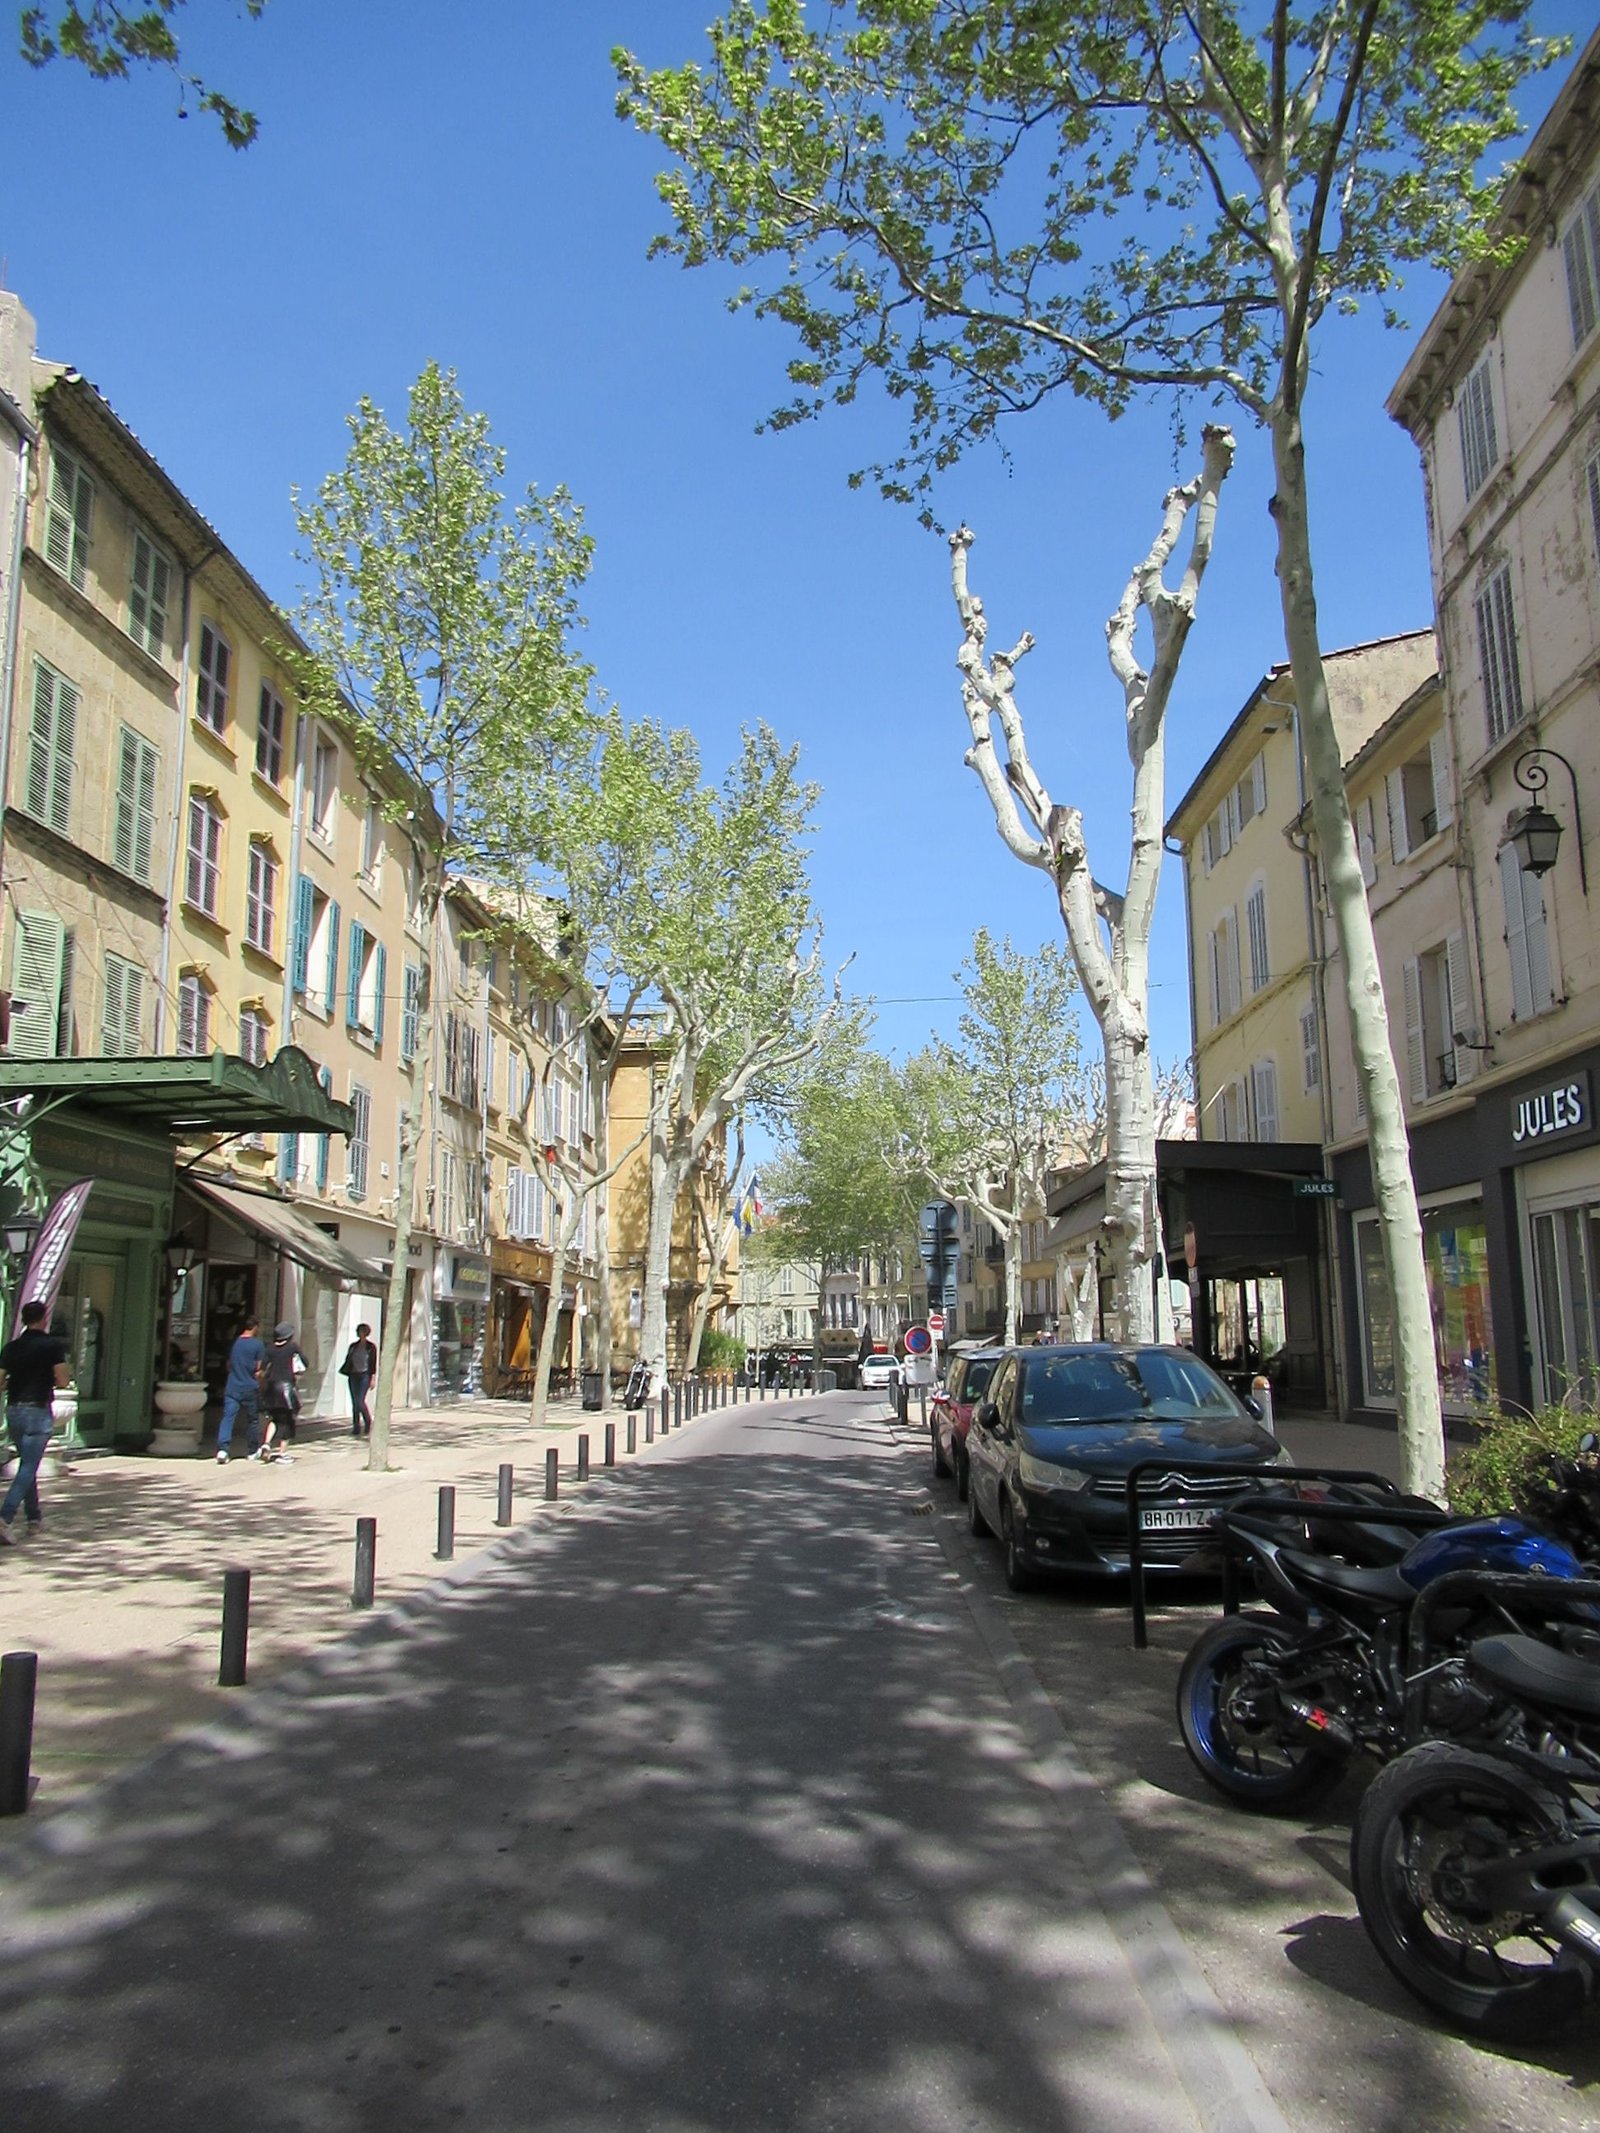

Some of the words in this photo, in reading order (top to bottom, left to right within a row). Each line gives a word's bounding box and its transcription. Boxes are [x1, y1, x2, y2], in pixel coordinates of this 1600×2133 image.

[1512, 1084, 1581, 1142] JULES
[1300, 1183, 1335, 1193] JULES
[1144, 1511, 1213, 1527] BA-071-Z
